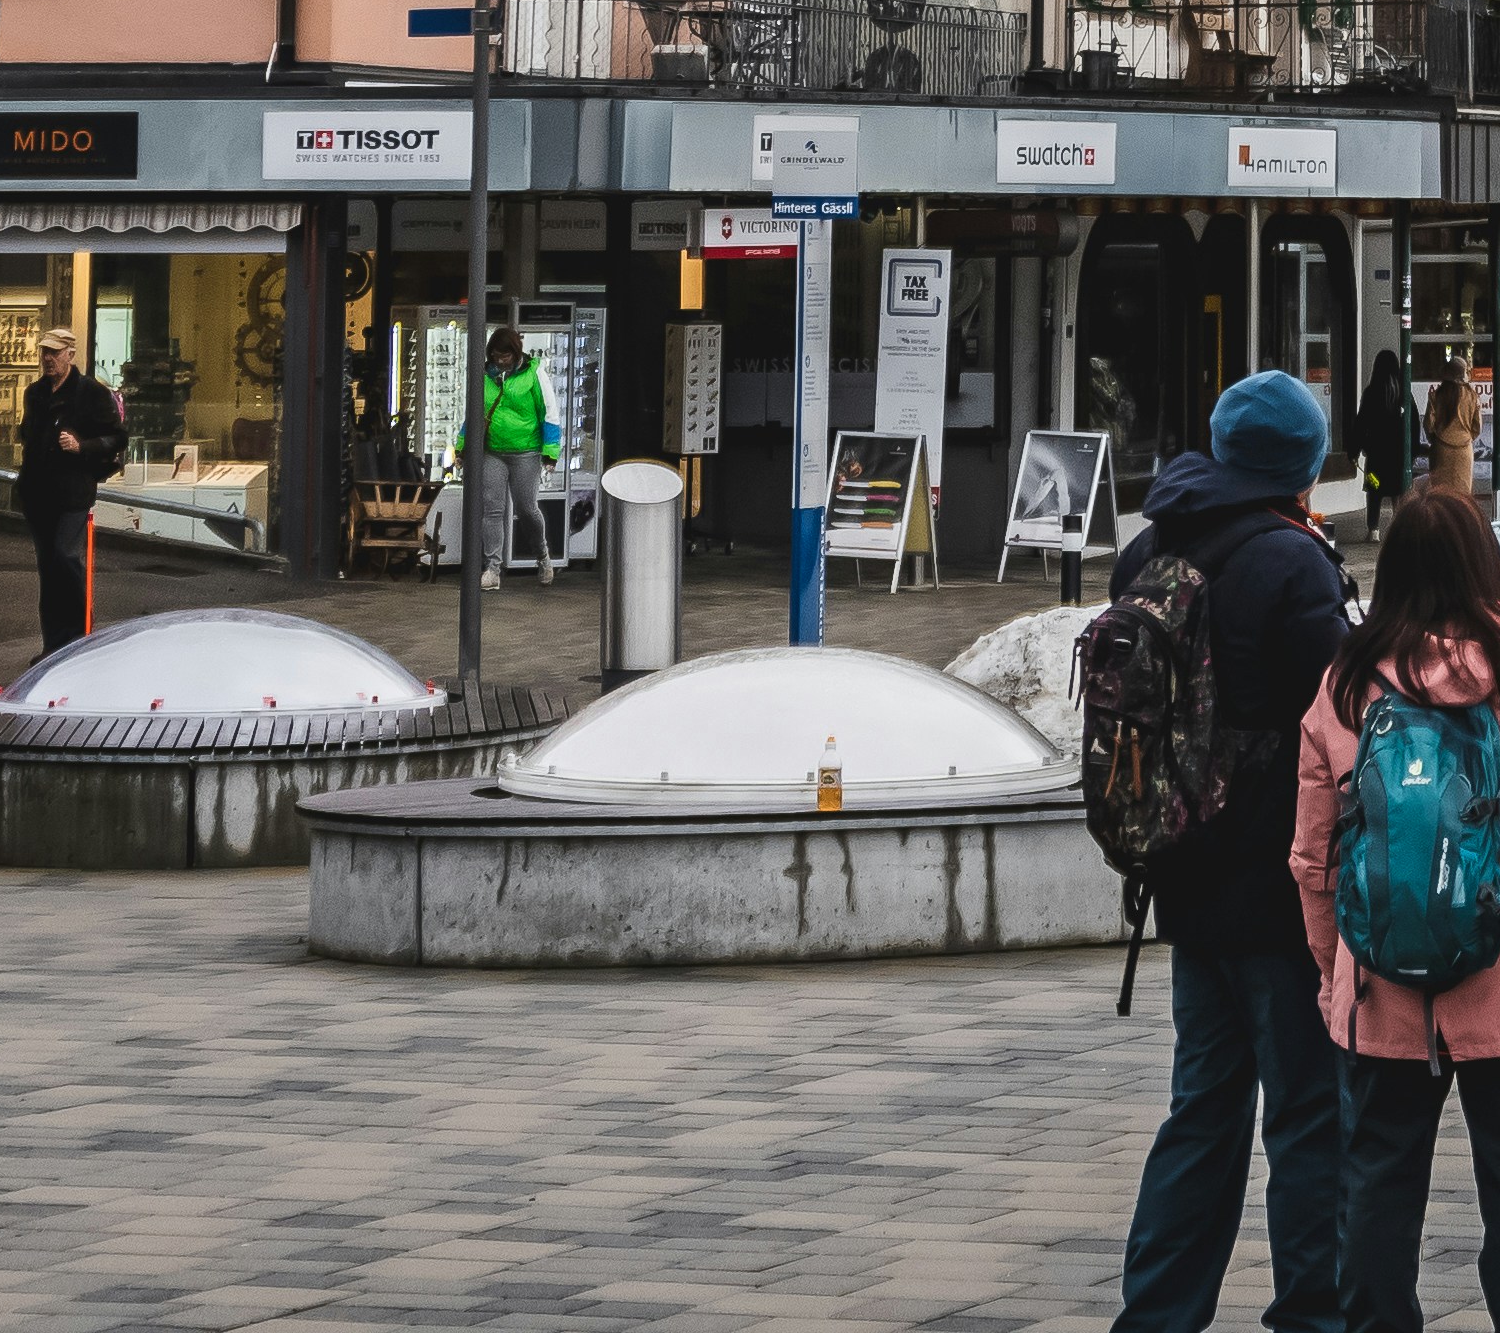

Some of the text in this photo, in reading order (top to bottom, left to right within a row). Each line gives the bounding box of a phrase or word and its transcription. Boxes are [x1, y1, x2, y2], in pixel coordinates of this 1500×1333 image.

[14, 130, 93, 151] MIDO
[336, 129, 440, 149] TISSOT
[295, 154, 328, 163] SWISS
[332, 154, 379, 163] WATCHES
[384, 154, 414, 163] SINCE
[780, 156, 845, 164] GRINDELWALD
[1016, 142, 1083, 166] swatch
[1244, 159, 1328, 174] HAMILTON
[774, 202, 853, 214] Hinteres Gässli
[740, 220, 798, 233] VICTORINO
[904, 275, 927, 288] TAX
[901, 288, 929, 301] FREE
